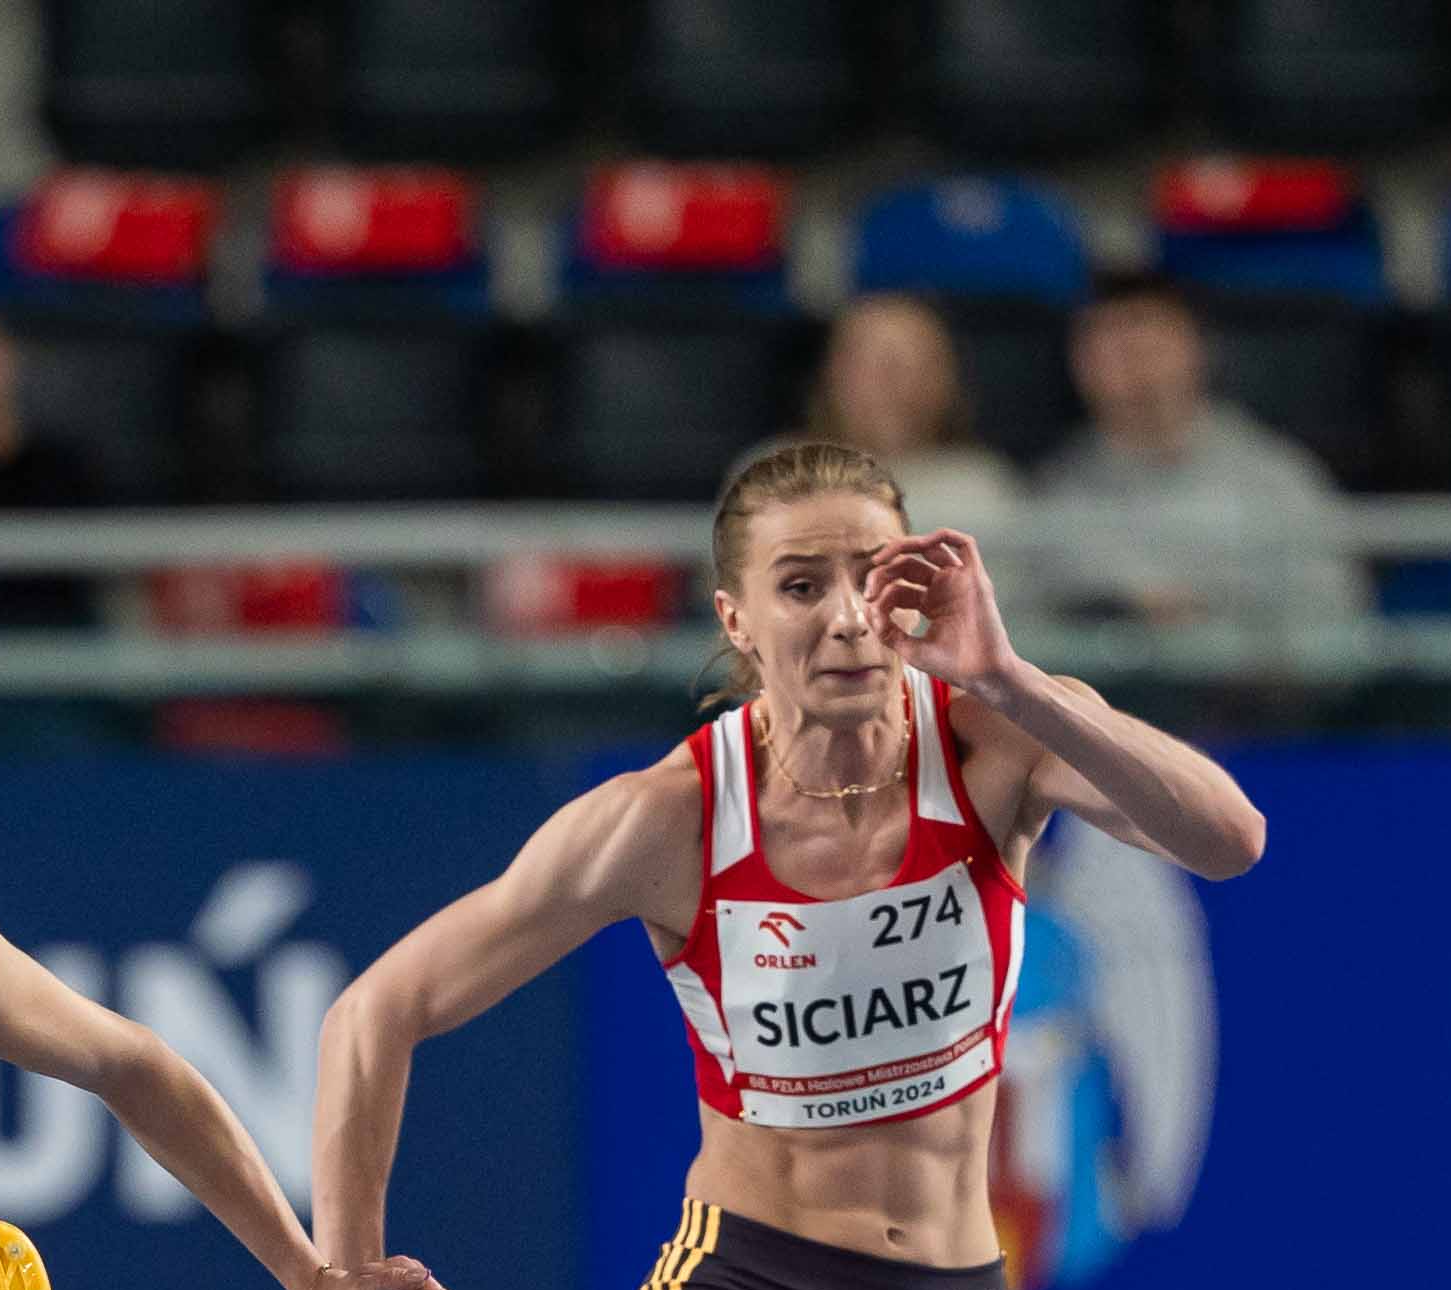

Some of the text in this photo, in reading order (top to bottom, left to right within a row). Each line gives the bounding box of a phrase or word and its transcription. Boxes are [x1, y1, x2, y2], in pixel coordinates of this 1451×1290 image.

[870, 885, 964, 949] 274
[754, 954, 816, 969] ORLEN
[752, 963, 971, 1048] SICIARZ
[803, 1075, 945, 1119] TORUŃ 2024
